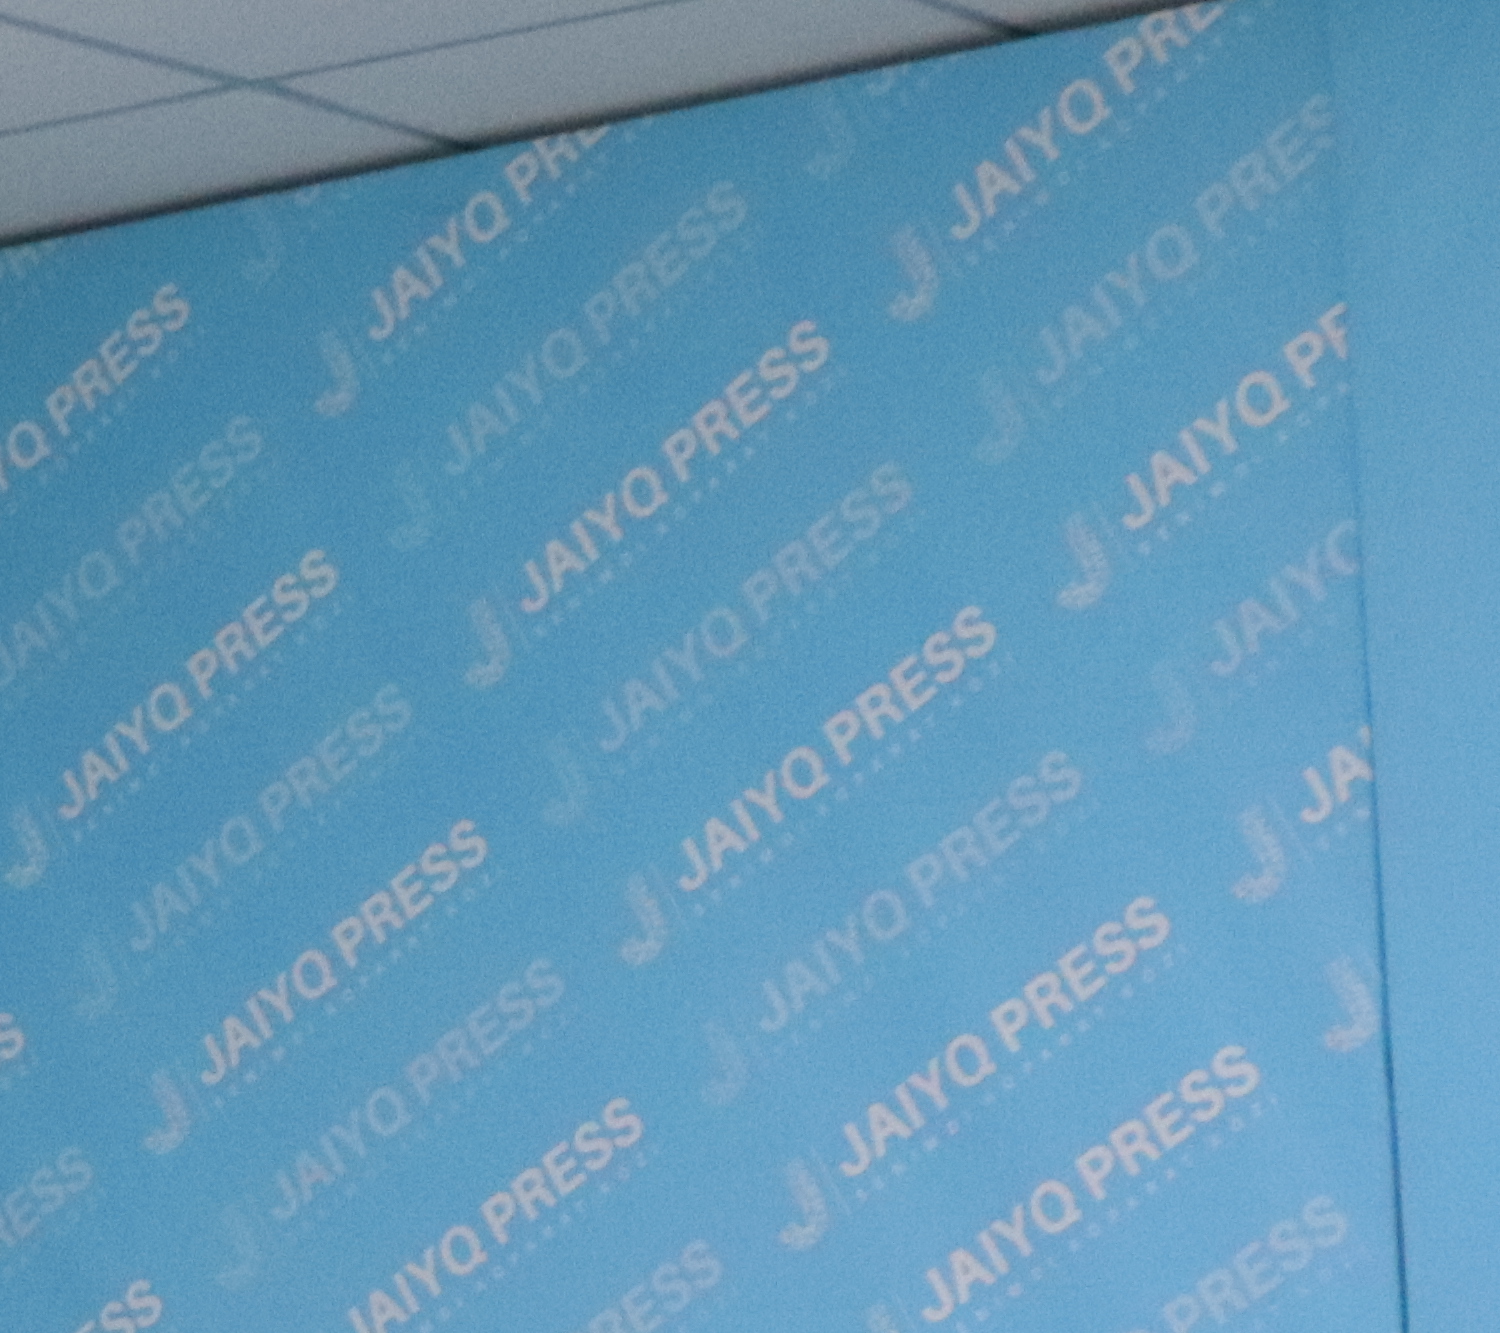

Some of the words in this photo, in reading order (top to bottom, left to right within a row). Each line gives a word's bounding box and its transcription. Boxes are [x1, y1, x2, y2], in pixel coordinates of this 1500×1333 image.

[951, 78, 1111, 241] JAIYQ
[1103, 4, 1225, 93] PRE
[45, 282, 191, 435] PRESS
[368, 190, 511, 340] JAIYQ
[520, 466, 669, 611] JAIYQ
[662, 320, 830, 482] PRESS
[1122, 370, 1291, 529] JAIYQ
[57, 682, 192, 819] JAIYQ
[188, 549, 339, 696] PRESS
[679, 746, 829, 891] JAIYQ
[823, 605, 997, 765] PRESS
[201, 949, 338, 1085] JAIYQ
[331, 819, 488, 966] PRESS
[839, 1033, 996, 1178] JAIYQ
[991, 896, 1171, 1052] PRESS
[481, 1098, 643, 1244] PRESS
[922, 1180, 1082, 1323] JAIYQ
[1075, 1044, 1260, 1199] PRESS
